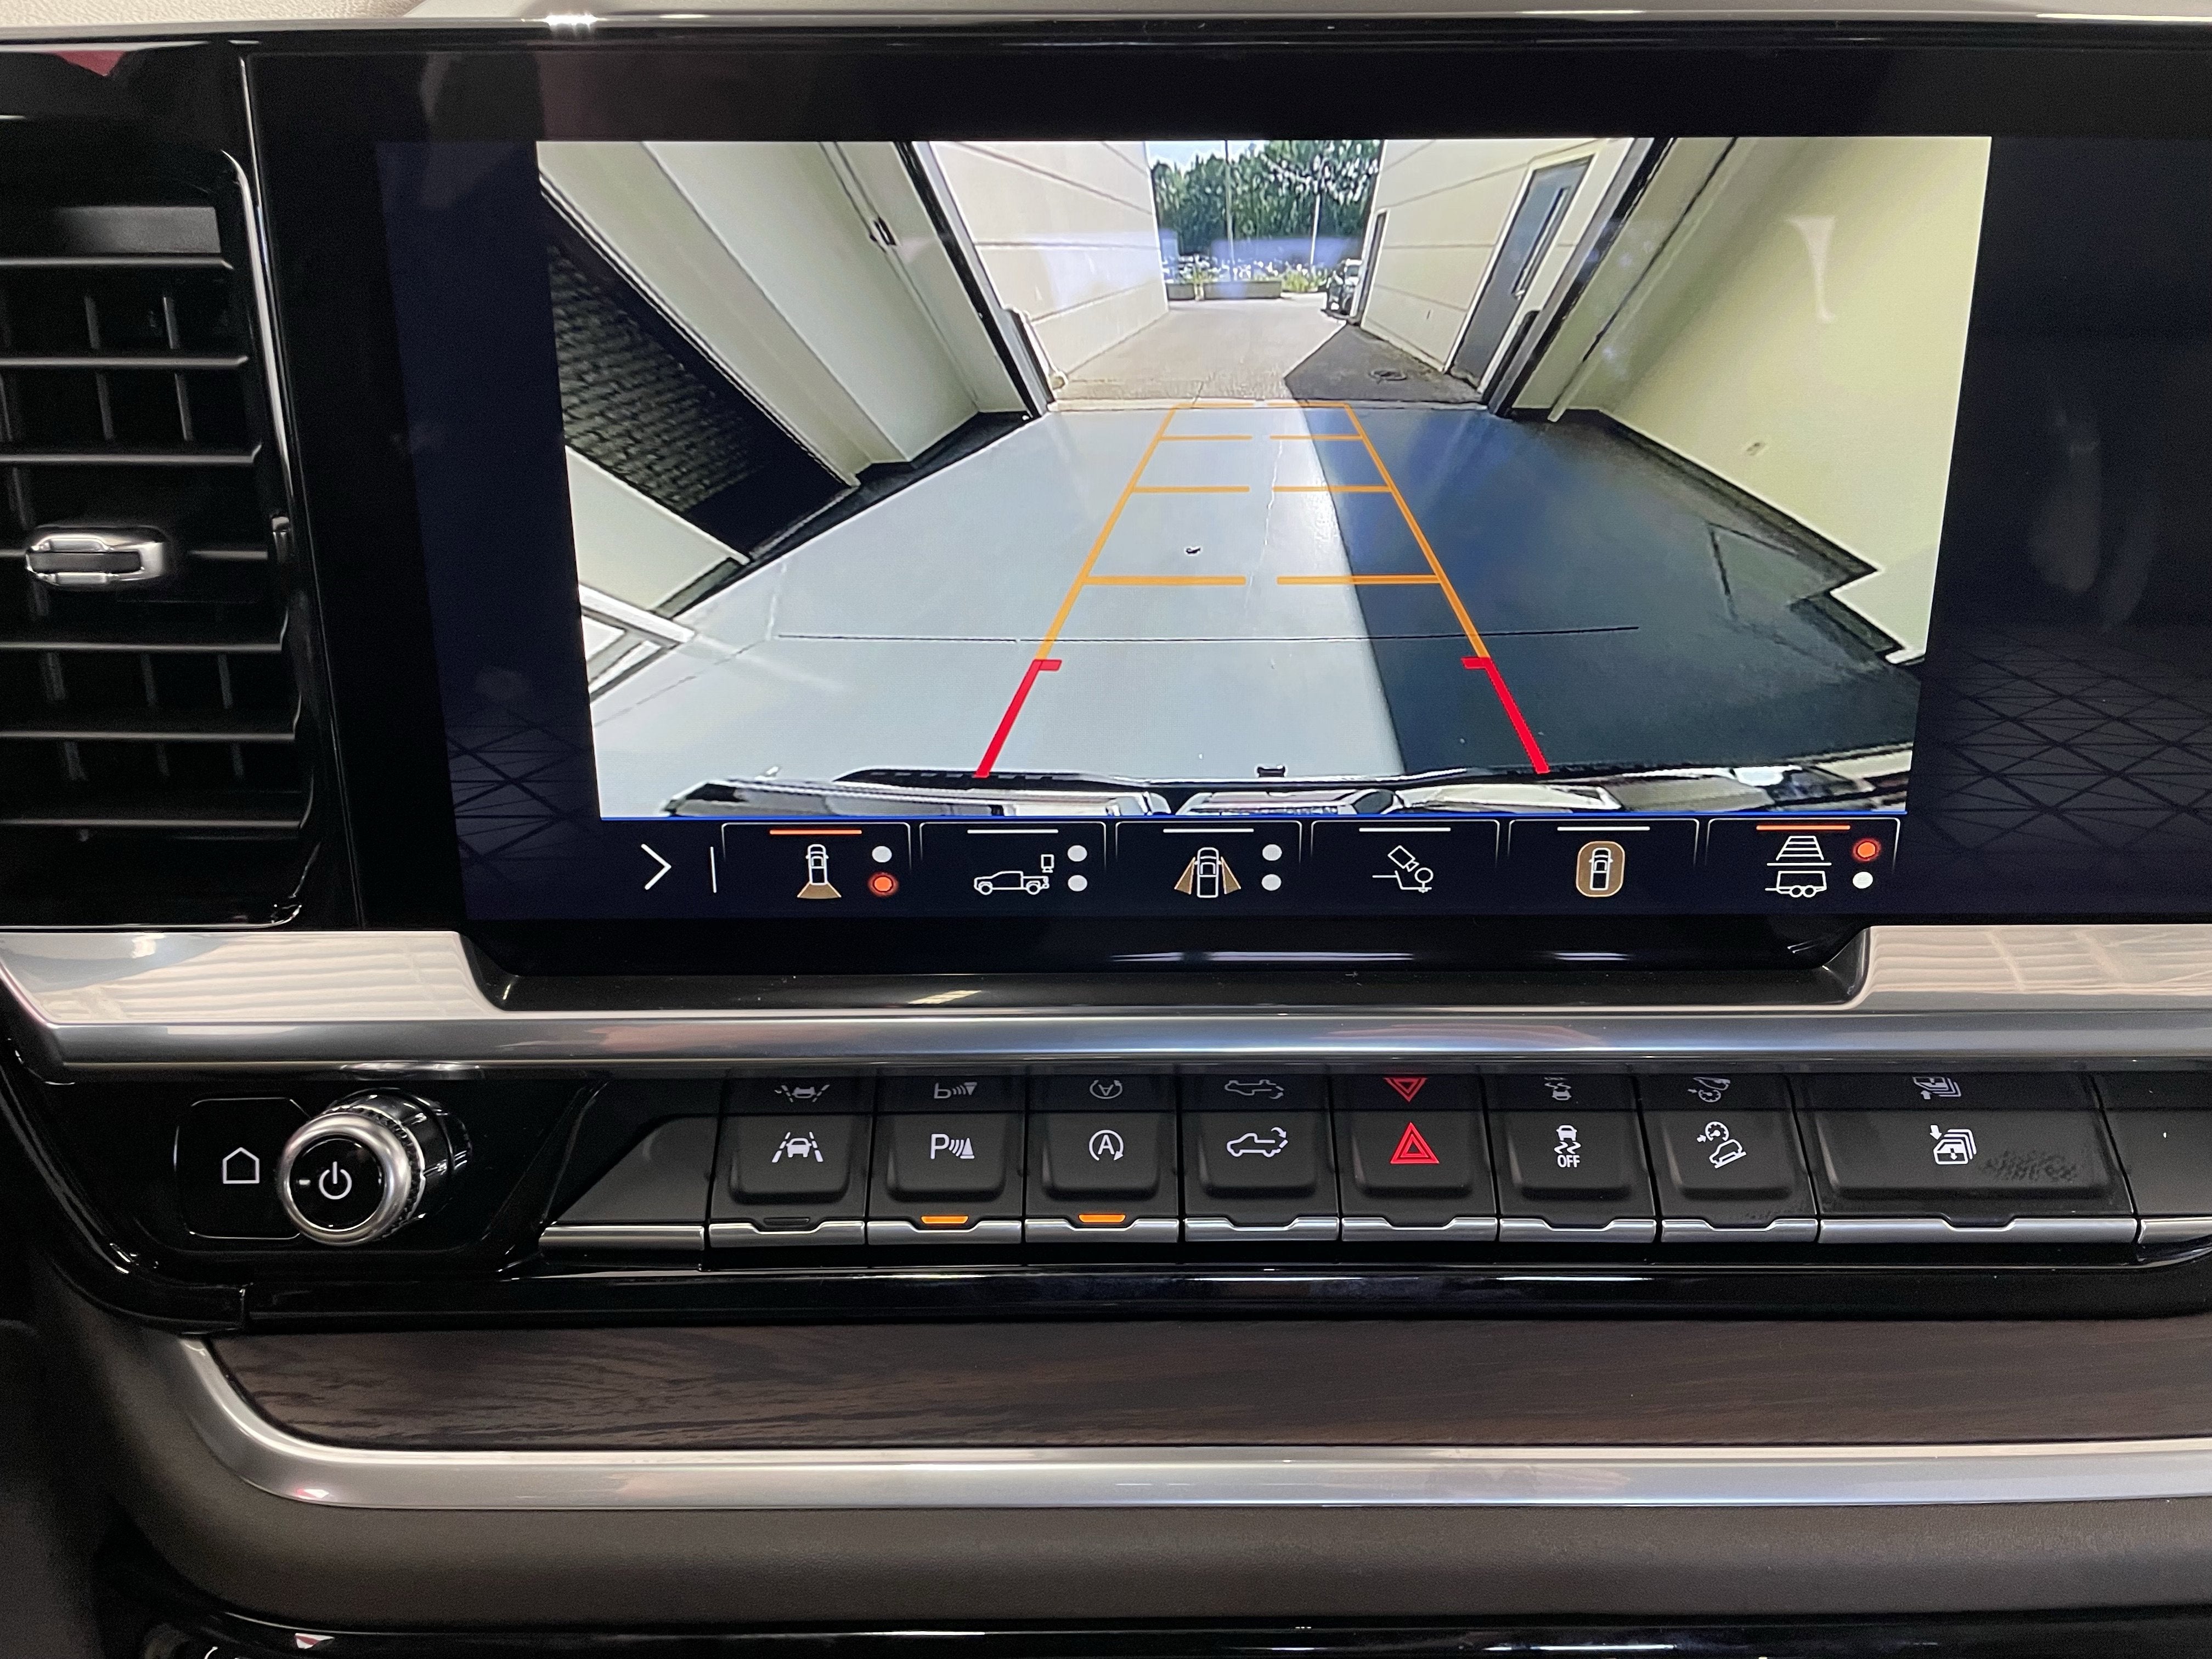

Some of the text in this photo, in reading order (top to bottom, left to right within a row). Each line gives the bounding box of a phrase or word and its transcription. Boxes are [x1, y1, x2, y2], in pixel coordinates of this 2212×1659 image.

[930, 1133, 950, 1160] P
[1097, 1135, 1115, 1155] A
[1557, 1154, 1581, 1168] OFF
